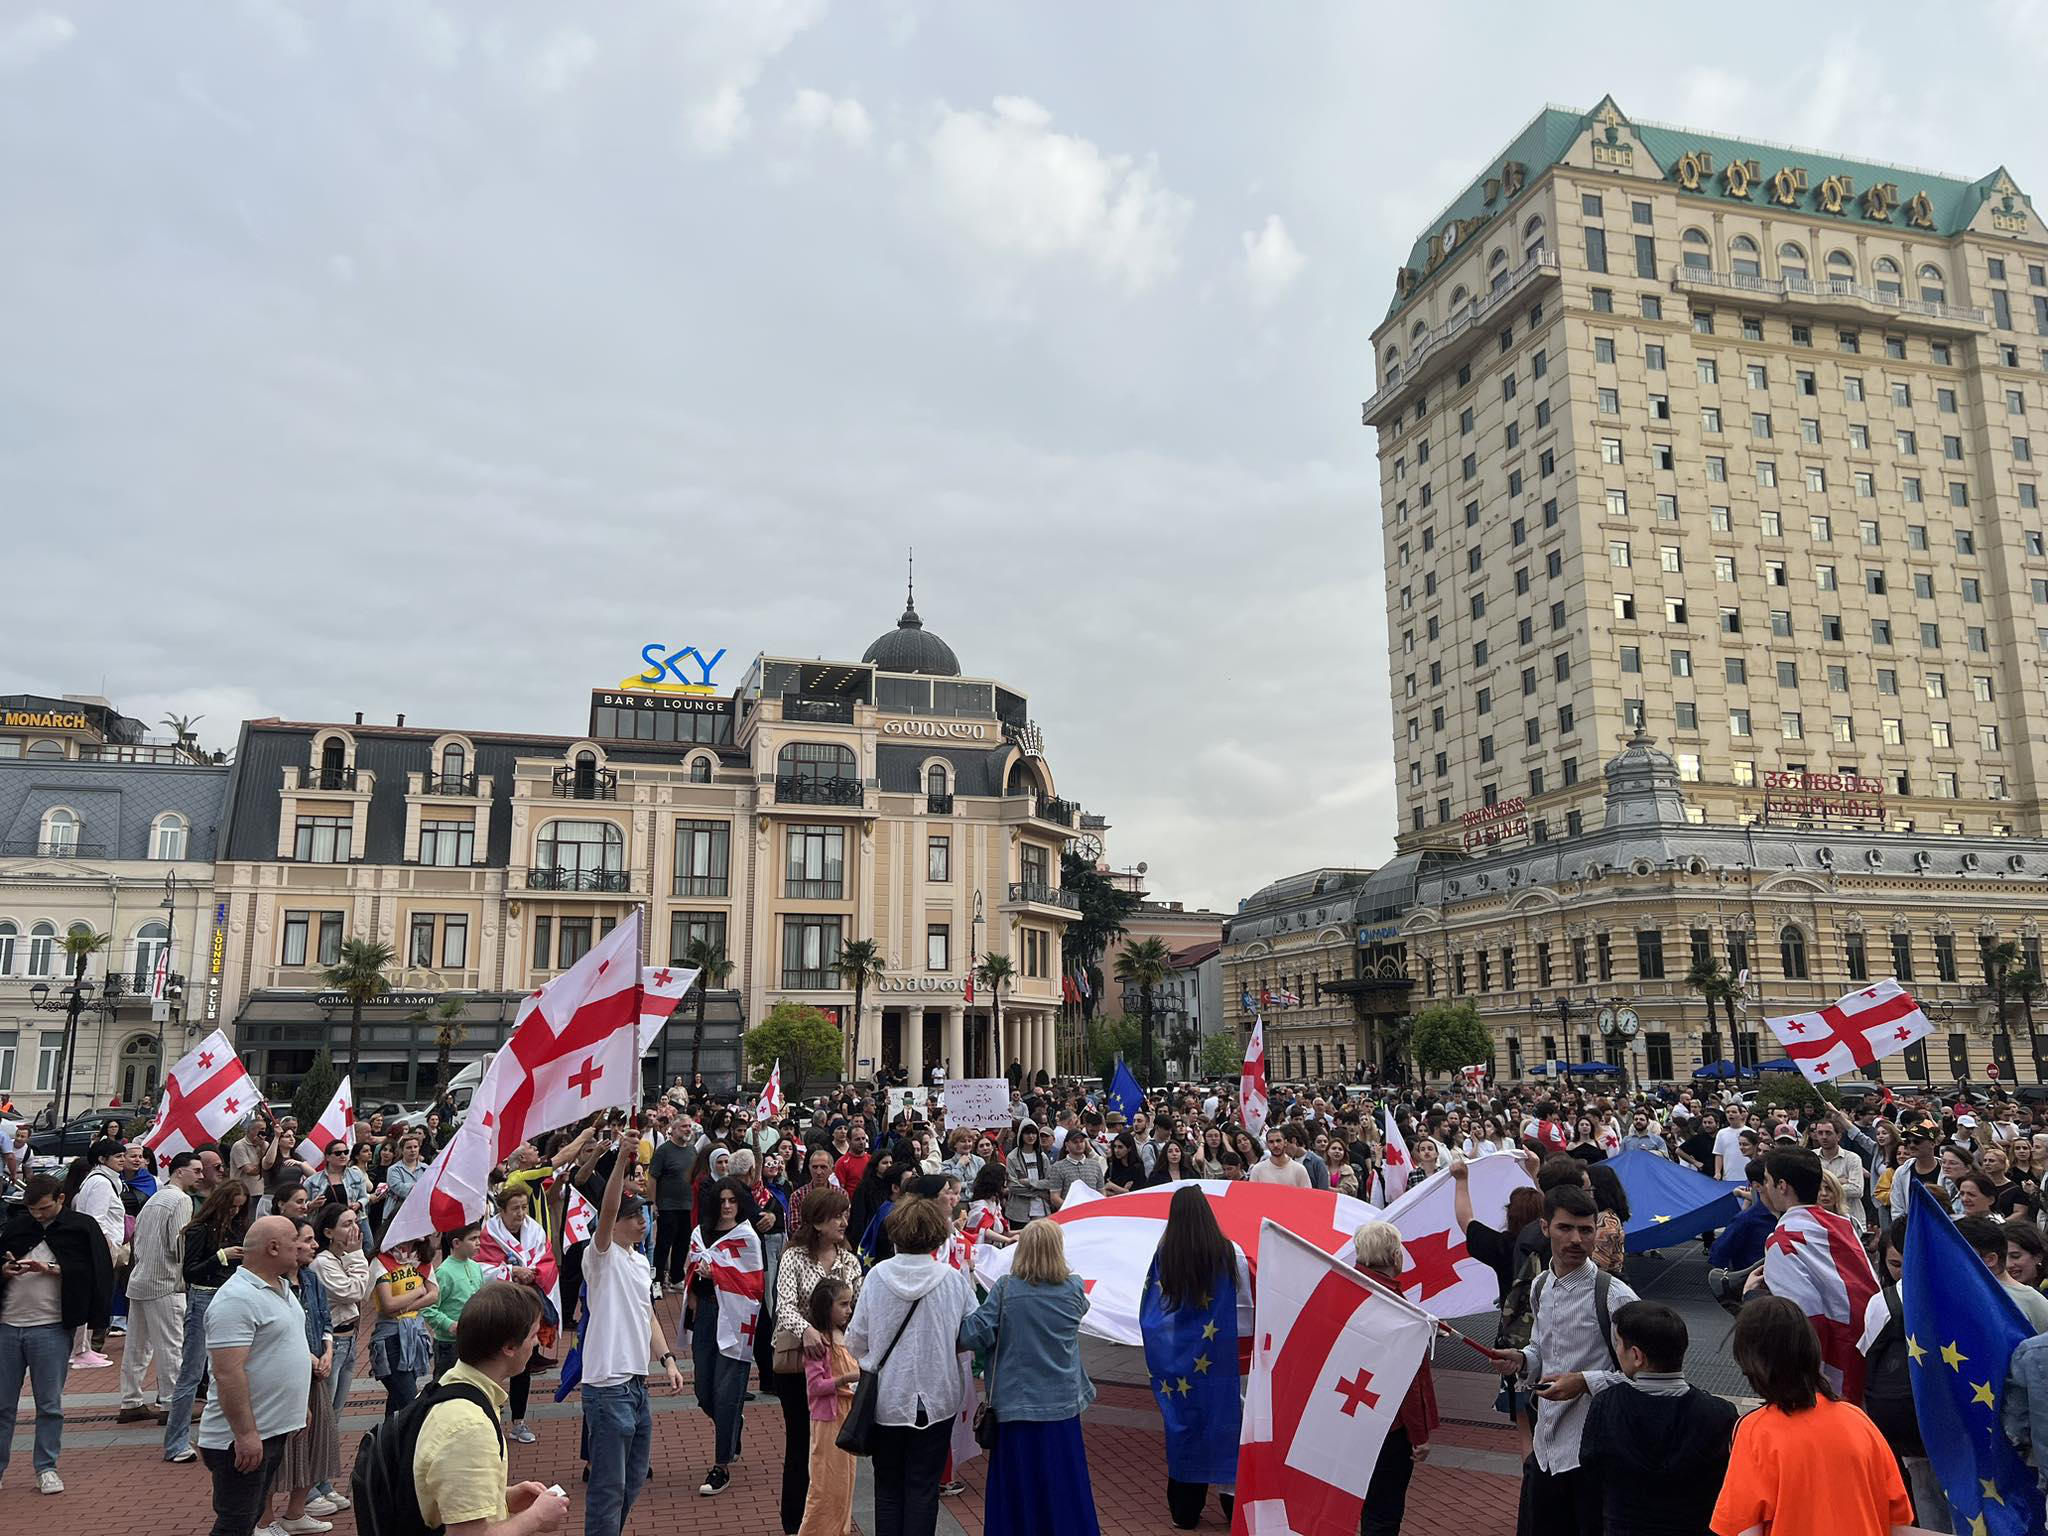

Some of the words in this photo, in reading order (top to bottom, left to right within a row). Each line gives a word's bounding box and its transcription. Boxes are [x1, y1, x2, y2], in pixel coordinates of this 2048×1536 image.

[604, 695, 634, 706] BAR
[644, 697, 654, 707] &
[664, 699, 725, 712] LOUNGE
[5, 712, 86, 728] MONARCH
[883, 720, 985, 739] როიალი
[1463, 796, 1526, 829] PRINCESS
[1463, 817, 1529, 852] CASINO
[212, 927, 223, 973] LOUNGE
[210, 977, 219, 985] &
[207, 989, 218, 1019] CLUB
[405, 996, 435, 1004] ბარი
